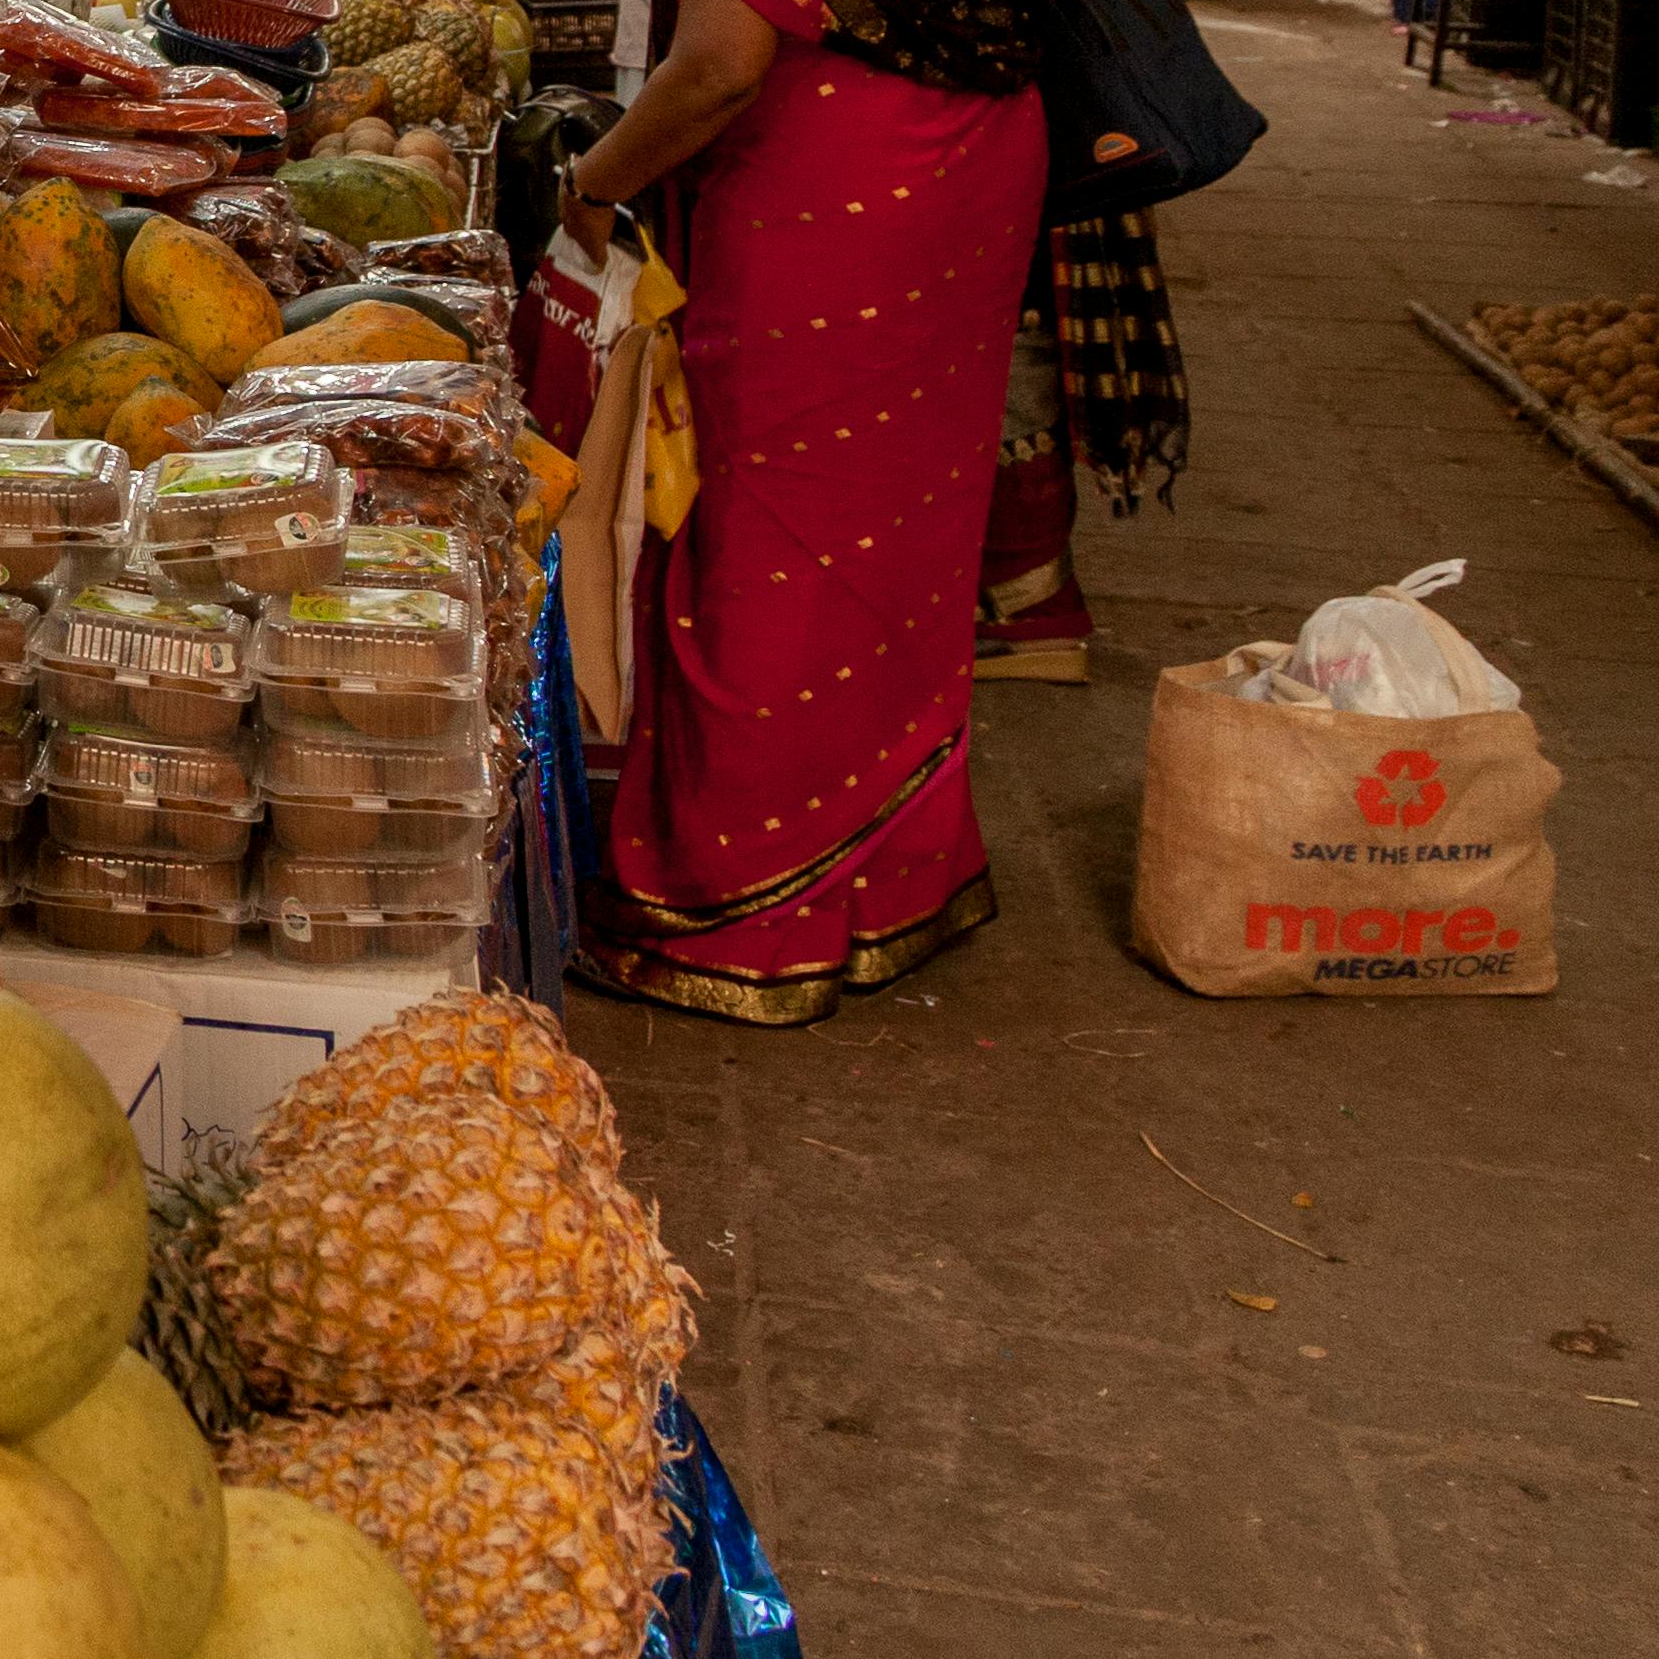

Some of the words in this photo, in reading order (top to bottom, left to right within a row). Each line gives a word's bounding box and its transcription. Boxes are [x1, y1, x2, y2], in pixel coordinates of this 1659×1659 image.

[1291, 840, 1358, 864] SAVE
[1368, 844, 1410, 865] THE
[1416, 840, 1493, 864] EARTH
[1246, 902, 1520, 954] more.
[1315, 951, 1516, 981] MEGASTORE
